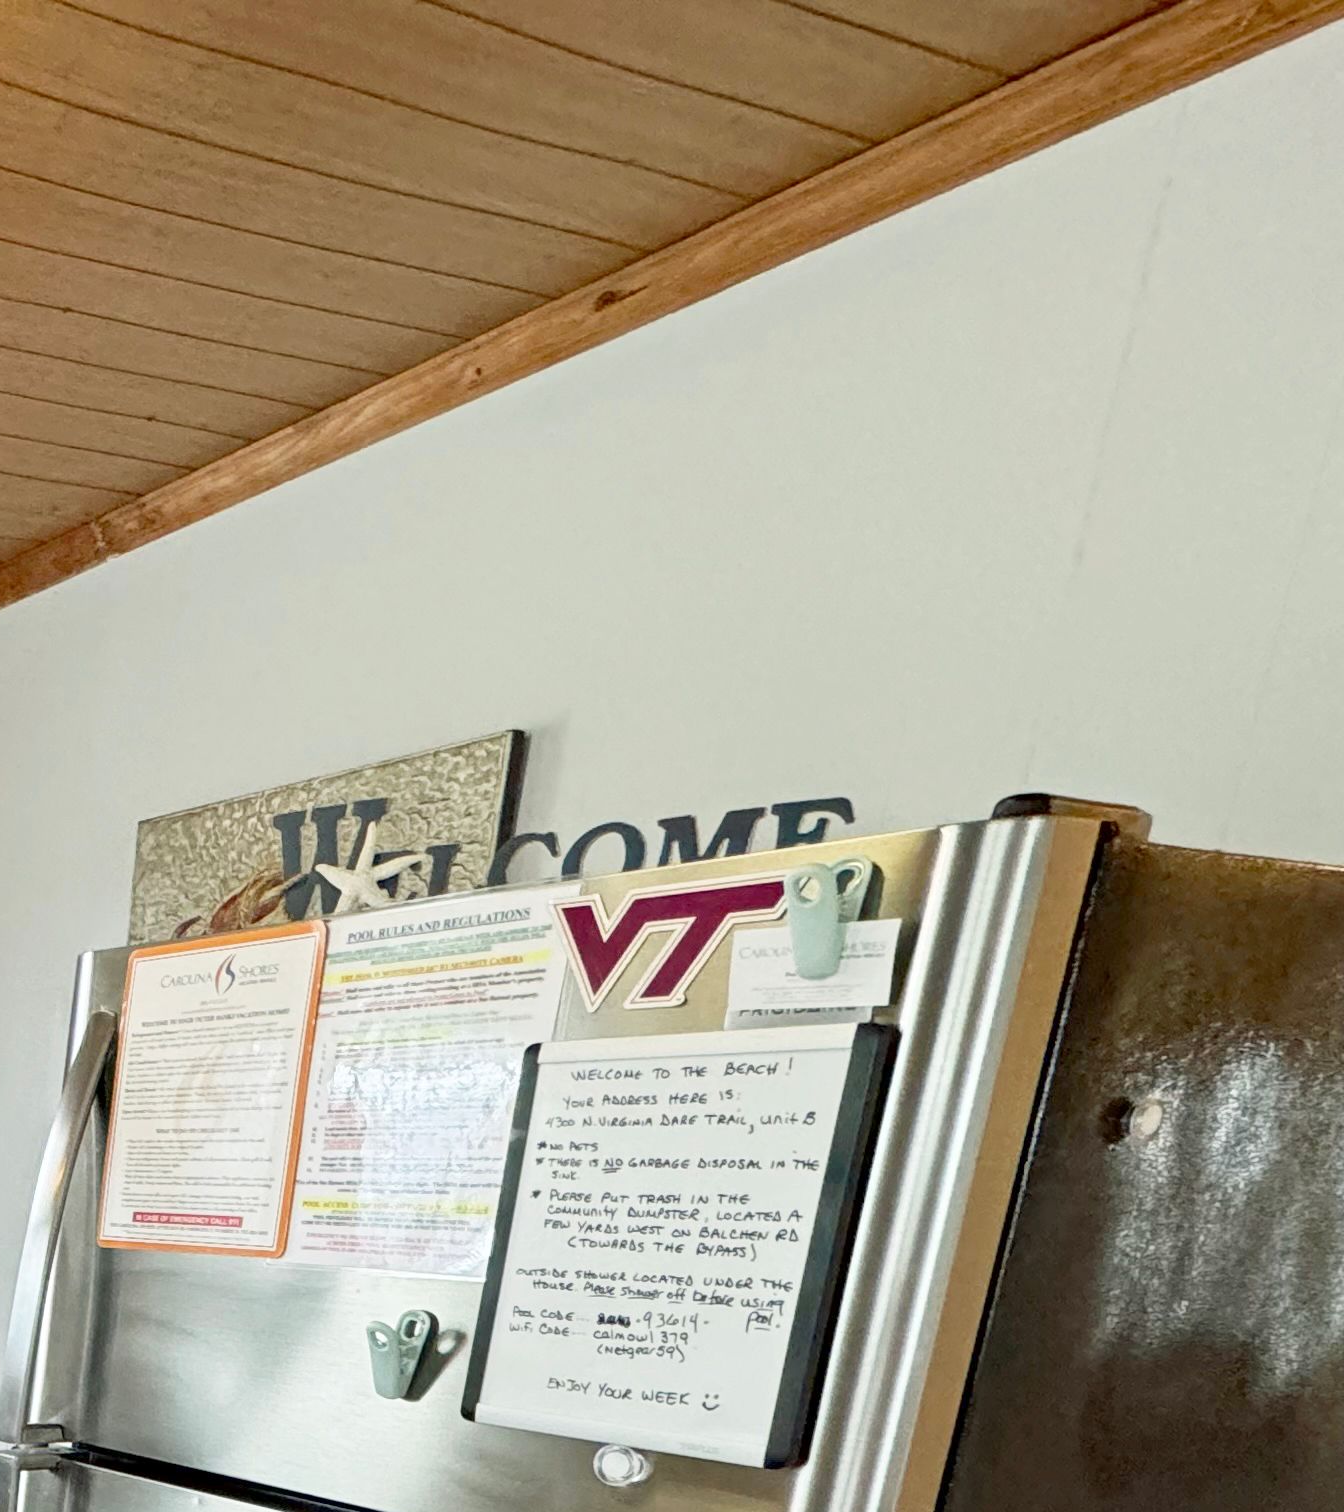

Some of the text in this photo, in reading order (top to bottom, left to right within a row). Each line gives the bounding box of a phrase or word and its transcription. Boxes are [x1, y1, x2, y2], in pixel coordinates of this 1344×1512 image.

[346, 907, 531, 944] POOL RULES AND REGULATIONS
[560, 878, 790, 1008] VT
[571, 1069, 643, 1081] WELCOME
[652, 1068, 670, 1080] TO
[681, 1066, 708, 1078] THE
[563, 1097, 594, 1110] YOUR
[602, 1094, 658, 1105] ADDRESS
[669, 1092, 708, 1104] HERE
[545, 1116, 575, 1128] 4300
[661, 1114, 698, 1126] DARE
[802, 1112, 816, 1126] B
[550, 1142, 598, 1152] NO PETS
[548, 1158, 820, 1174] THERE IS NO GARBAGE DISPOSAL IN THE
[550, 1189, 750, 1205] PLEASE PUT TRASH IN THE
[716, 1210, 781, 1221] LOCATED
[787, 1210, 803, 1221] A
[544, 1219, 798, 1242] FEW YARDS WEST ON BALCHEN RD
[567, 1237, 644, 1253] (TOWARDS
[652, 1241, 683, 1253] THE
[516, 1267, 794, 1292] OUTSIDE SHOWER LOCATED UNDER THE
[666, 1289, 686, 1304] off
[692, 1290, 734, 1306] before
[740, 1293, 785, 1314] using
[540, 1307, 574, 1321] CODE
[539, 1323, 571, 1337] CODE
[546, 1376, 691, 1406] ENJOY YOUR WEEK
